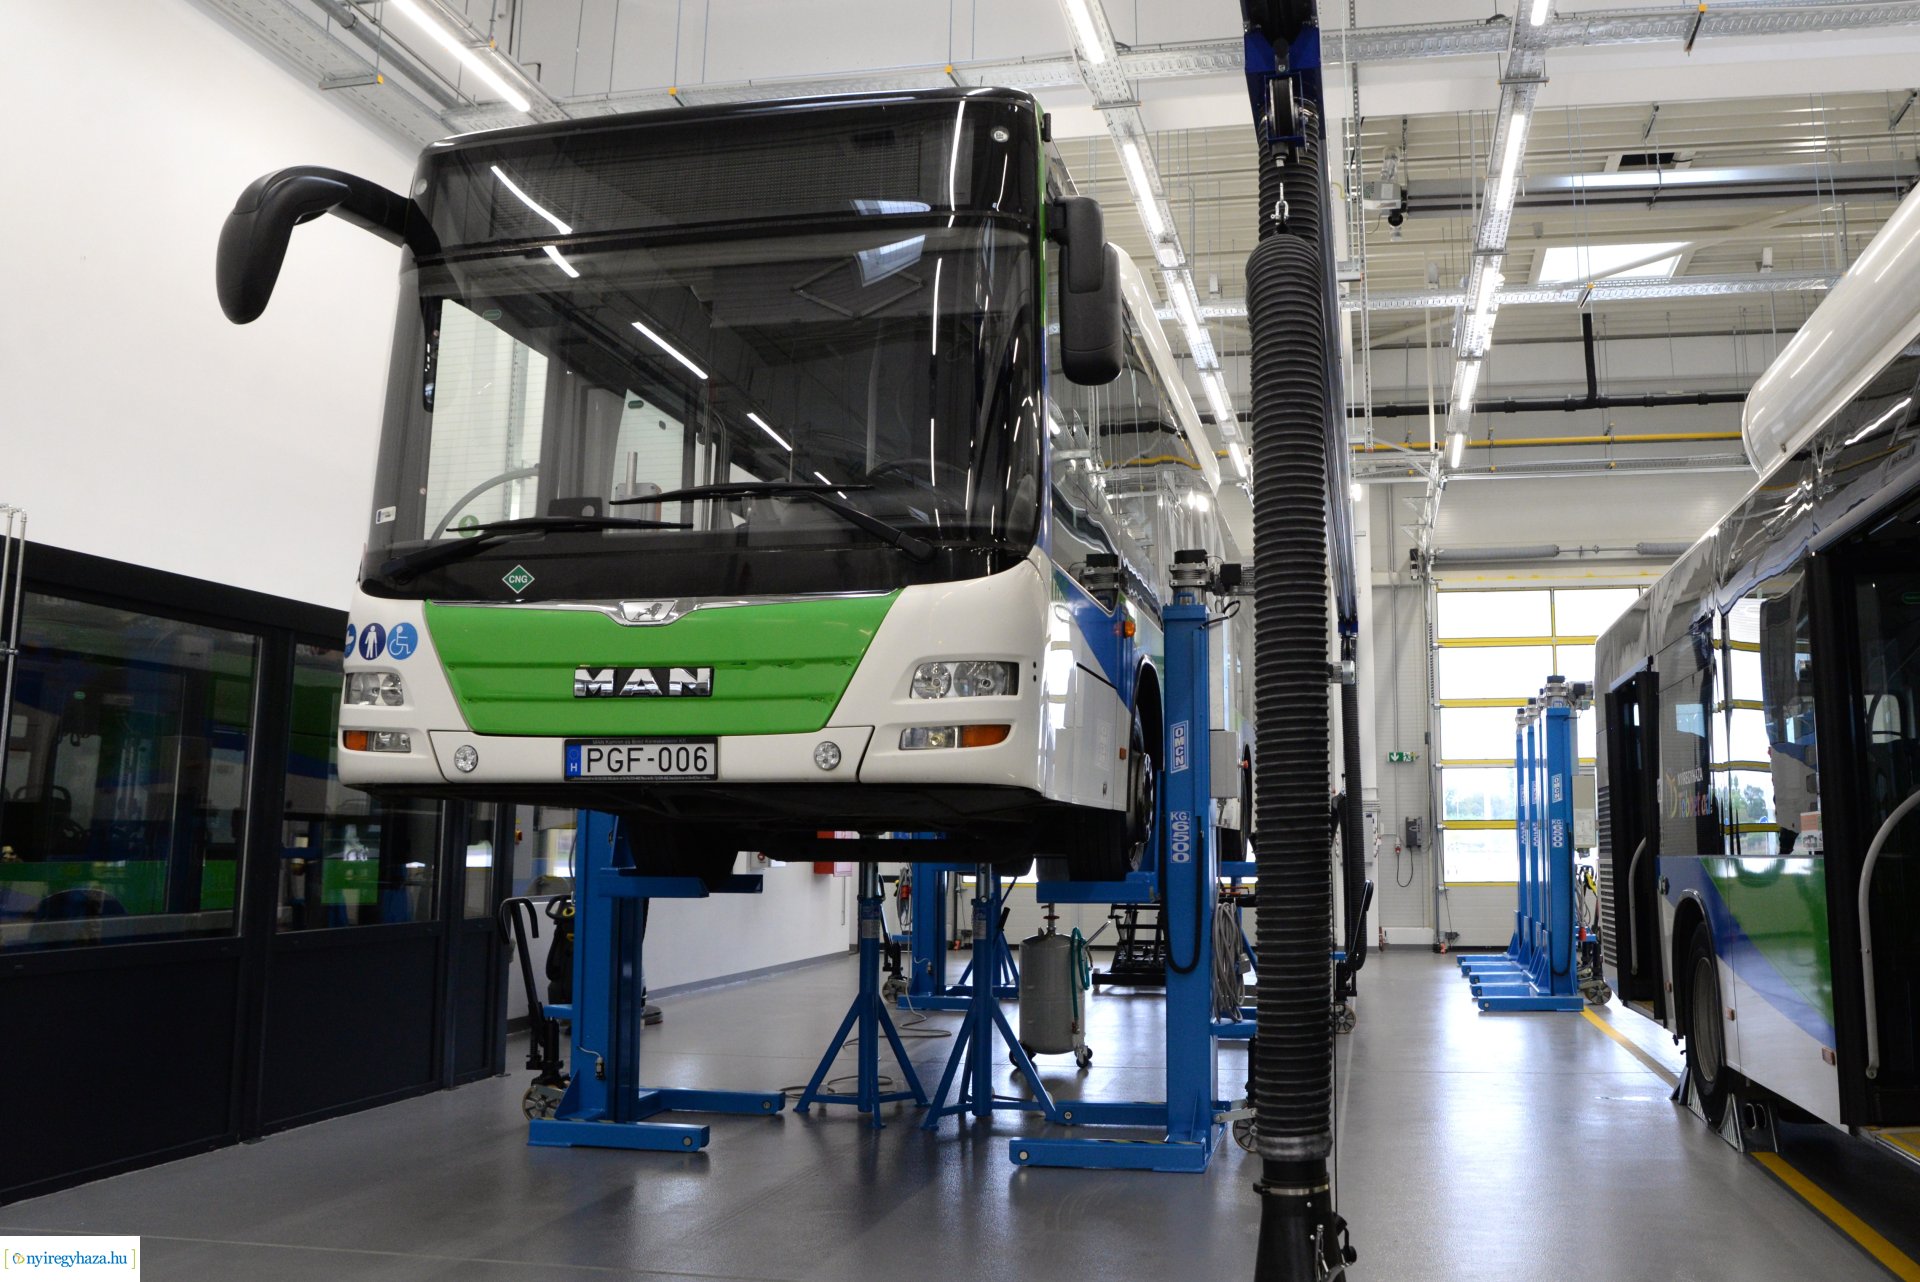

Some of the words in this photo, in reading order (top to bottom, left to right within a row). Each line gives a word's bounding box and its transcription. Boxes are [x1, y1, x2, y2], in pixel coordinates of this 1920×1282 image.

[508, 575, 528, 584] CNG
[574, 668, 711, 697] MAN
[587, 746, 708, 773] PGF-006
[1174, 727, 1185, 766] OMCN
[570, 762, 578, 772] H
[1171, 821, 1190, 863] 6500
